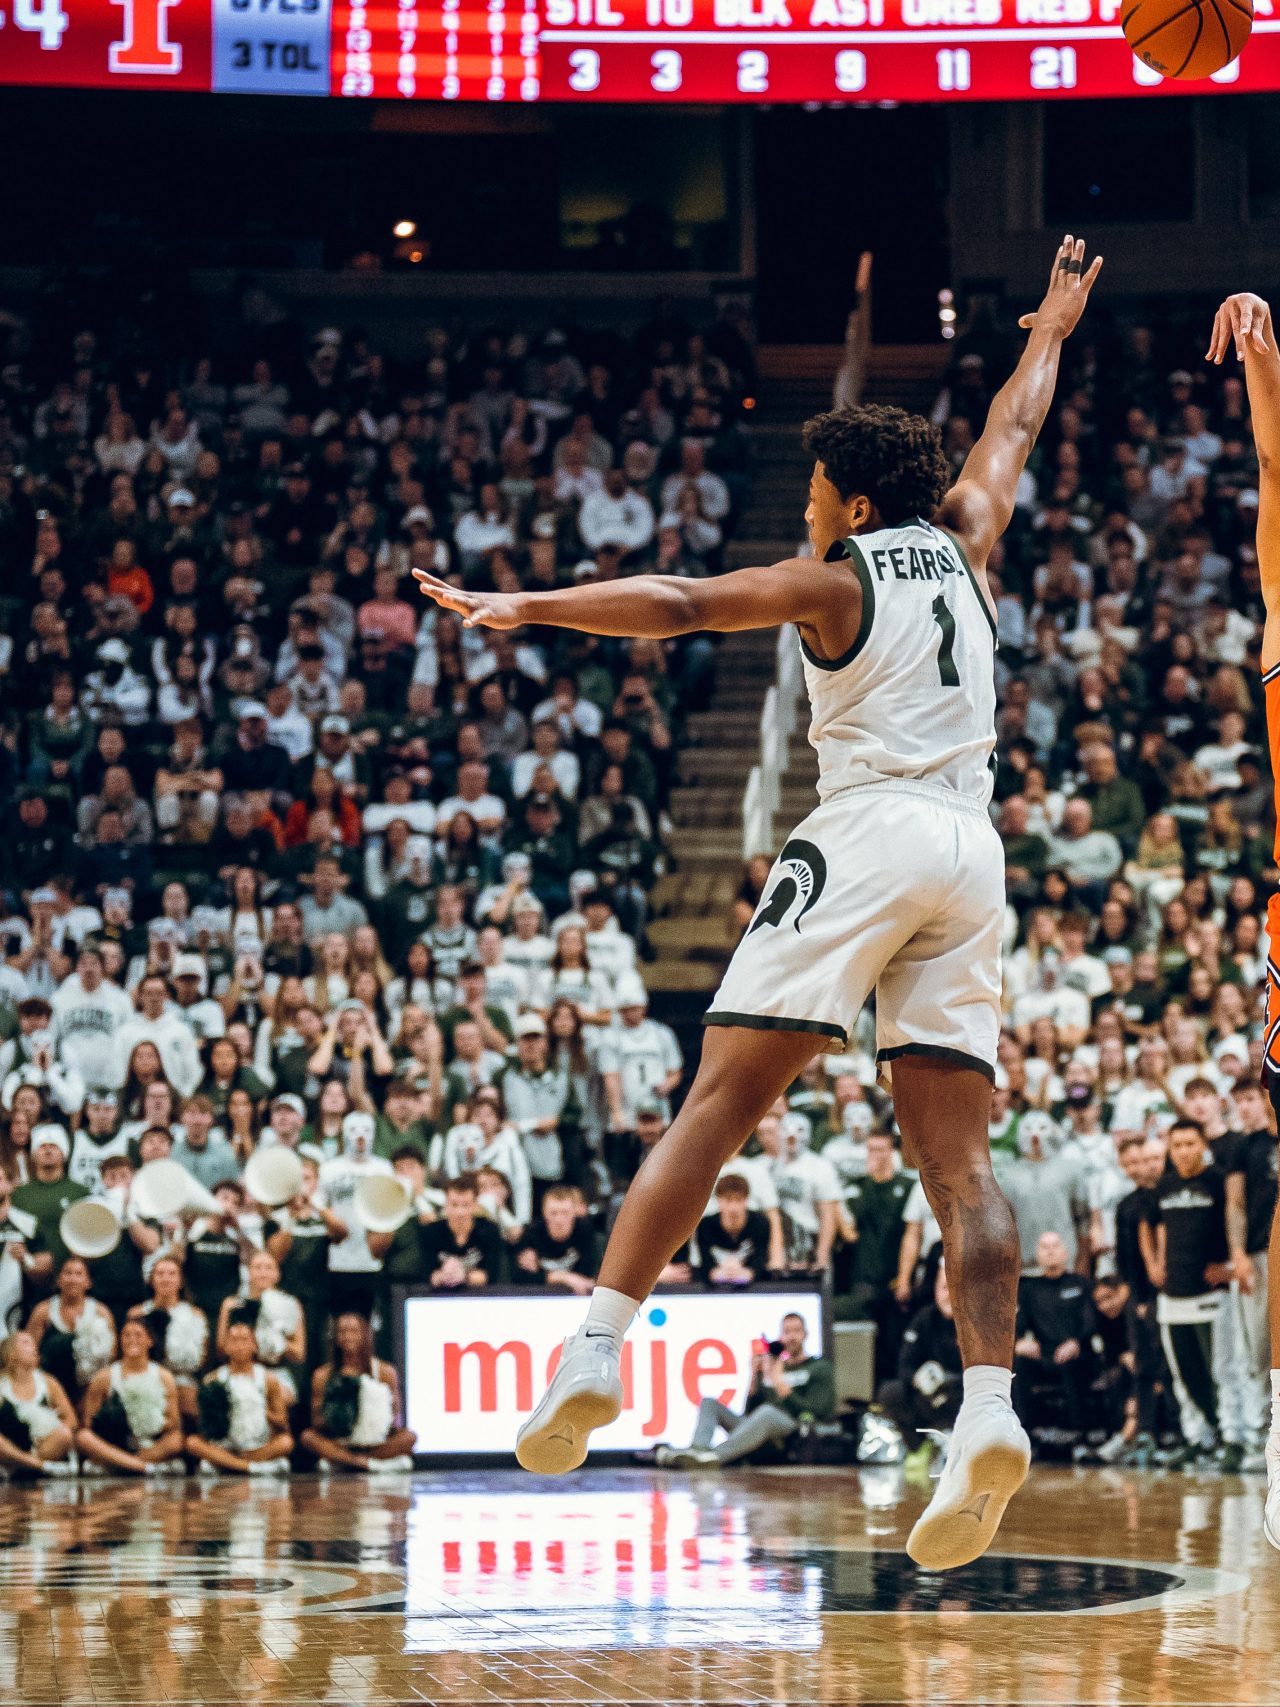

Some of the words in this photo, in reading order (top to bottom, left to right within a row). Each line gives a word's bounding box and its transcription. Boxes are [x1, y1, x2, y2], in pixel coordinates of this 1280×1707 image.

[0, 0, 69, 50] 4
[231, 41, 251, 69] 3
[260, 42, 321, 72] TOL
[568, 49, 600, 91] 3
[650, 49, 682, 92] 3
[737, 50, 769, 92] 2
[835, 49, 866, 92] 9
[936, 48, 970, 91] 11
[1030, 46, 1077, 89] 21
[932, 594, 961, 686] 1
